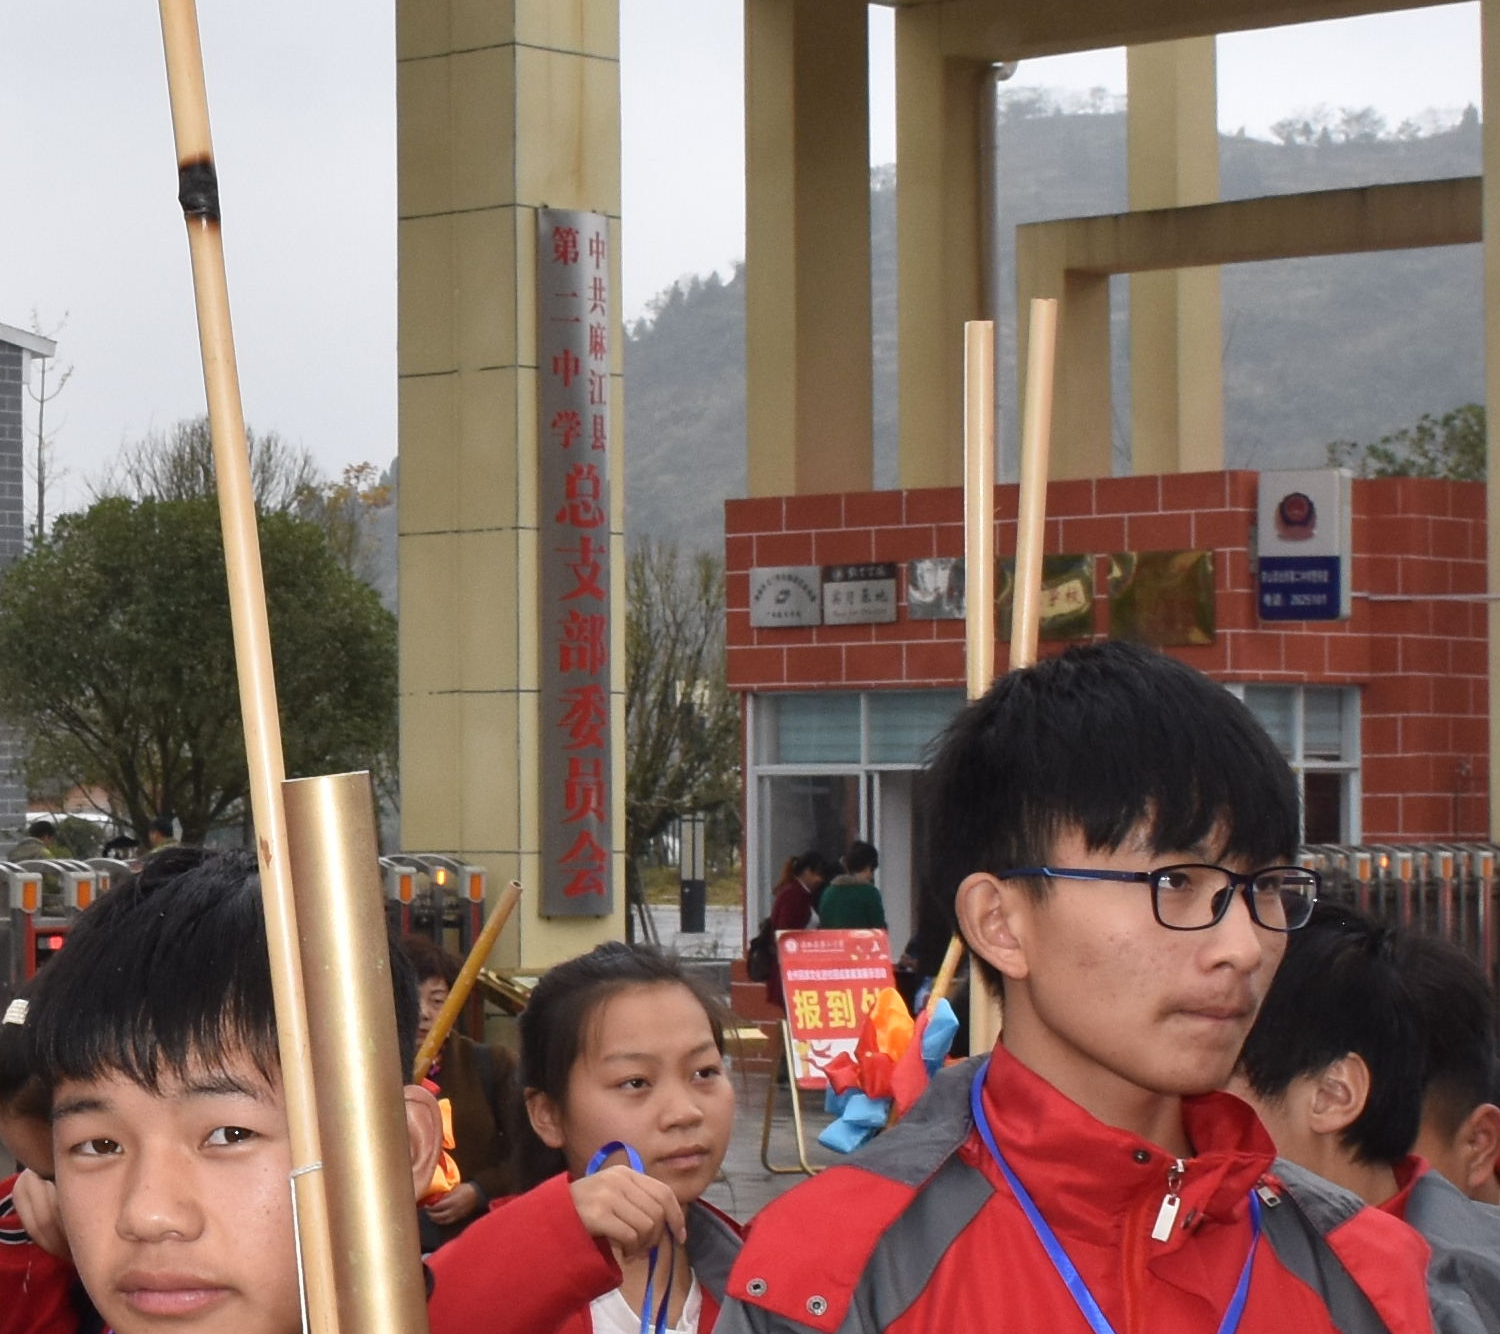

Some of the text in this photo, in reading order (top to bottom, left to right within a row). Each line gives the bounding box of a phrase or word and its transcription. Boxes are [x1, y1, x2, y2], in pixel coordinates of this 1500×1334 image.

[551, 225, 582, 449] 第二中学
[588, 230, 607, 452] 中共麻江县
[555, 461, 609, 899] 总支部委员会
